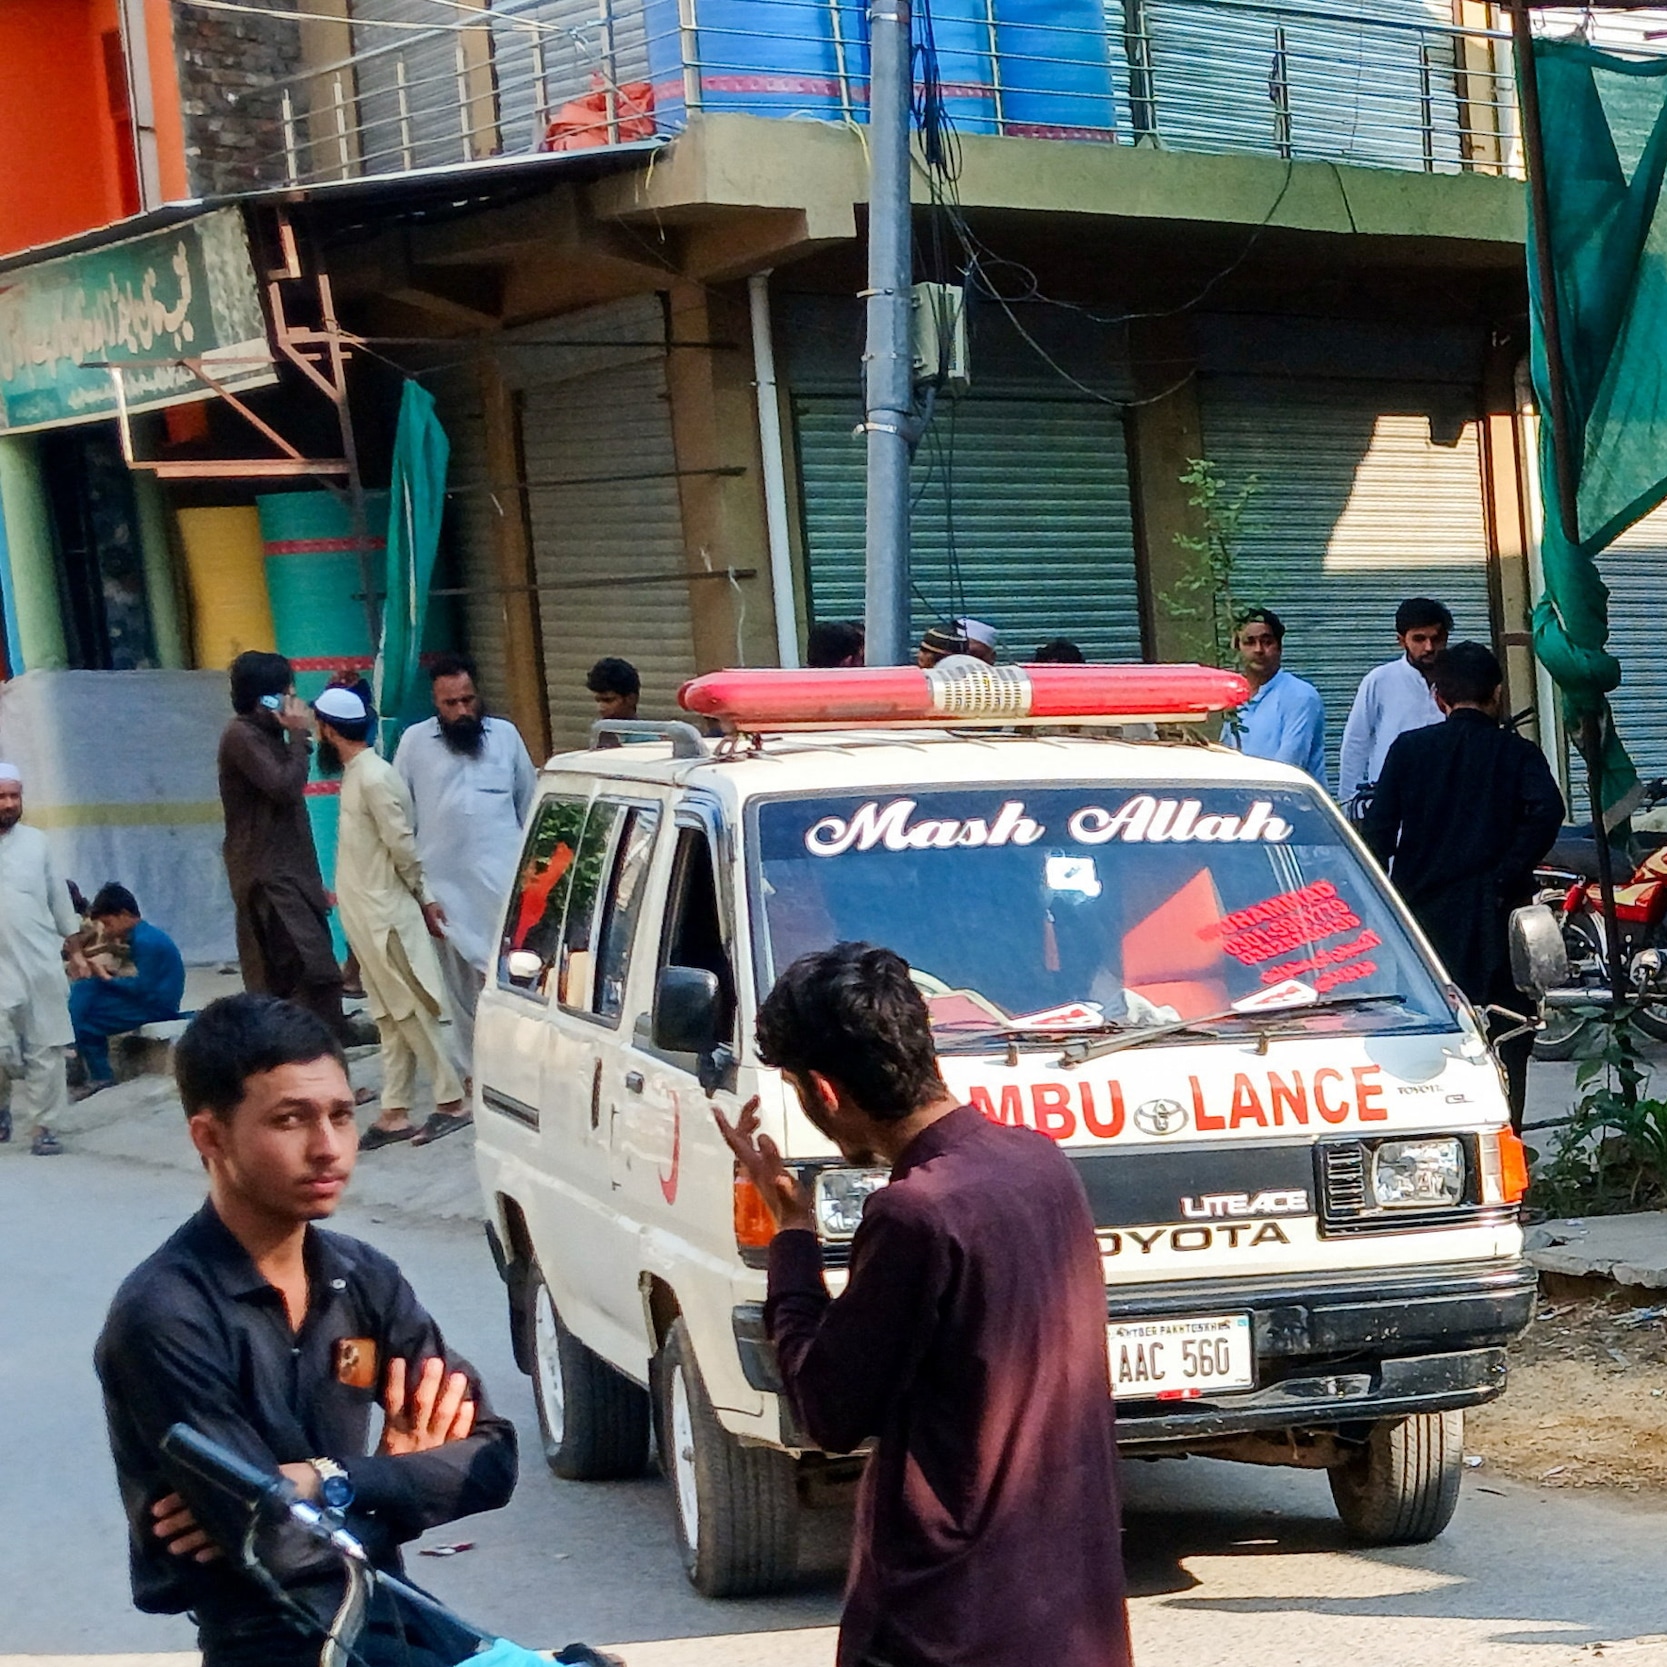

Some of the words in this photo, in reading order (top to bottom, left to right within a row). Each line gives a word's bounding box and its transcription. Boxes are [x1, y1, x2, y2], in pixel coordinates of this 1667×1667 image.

[805, 796, 1045, 857] Mash
[1069, 795, 1293, 843] Allah
[969, 1079, 1125, 1140] MBU
[1188, 1064, 1388, 1132] LANCE
[1097, 1222, 1291, 1256] OYOTA
[1119, 1342, 1166, 1383] AAC
[1182, 1337, 1230, 1378] 560
